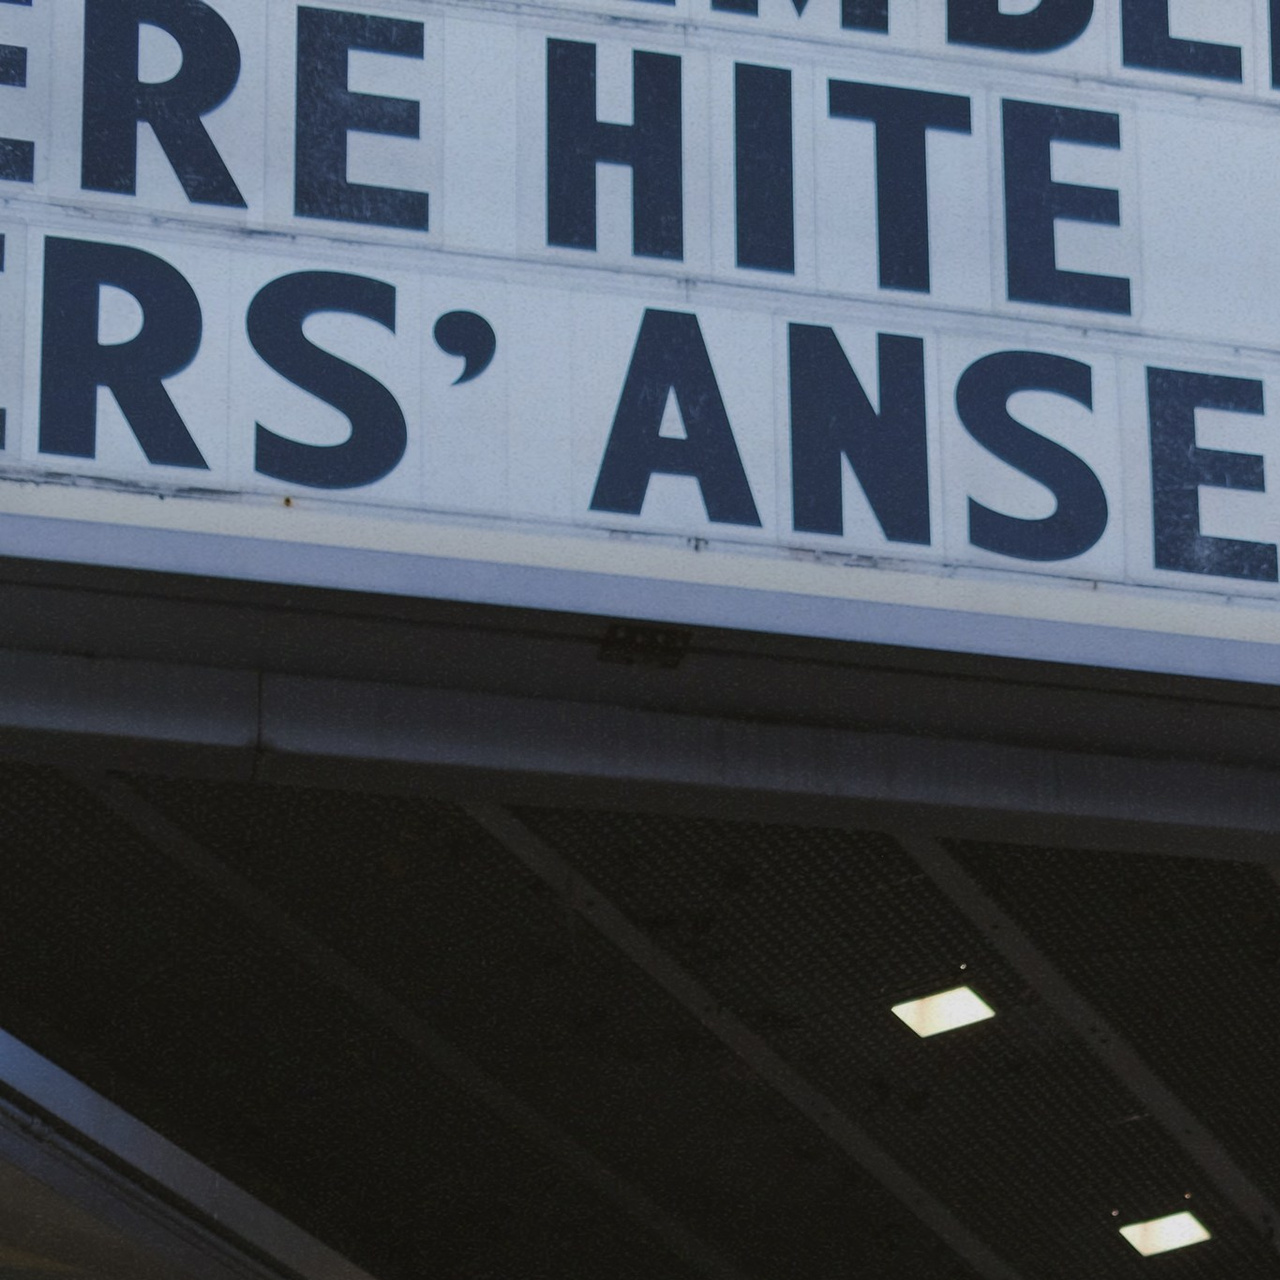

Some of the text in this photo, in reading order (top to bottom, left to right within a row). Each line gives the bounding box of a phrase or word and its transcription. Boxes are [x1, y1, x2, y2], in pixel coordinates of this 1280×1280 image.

[0, 0, 431, 232] RE
[546, 37, 1133, 317] HITE
[0, 234, 498, 490] RS’
